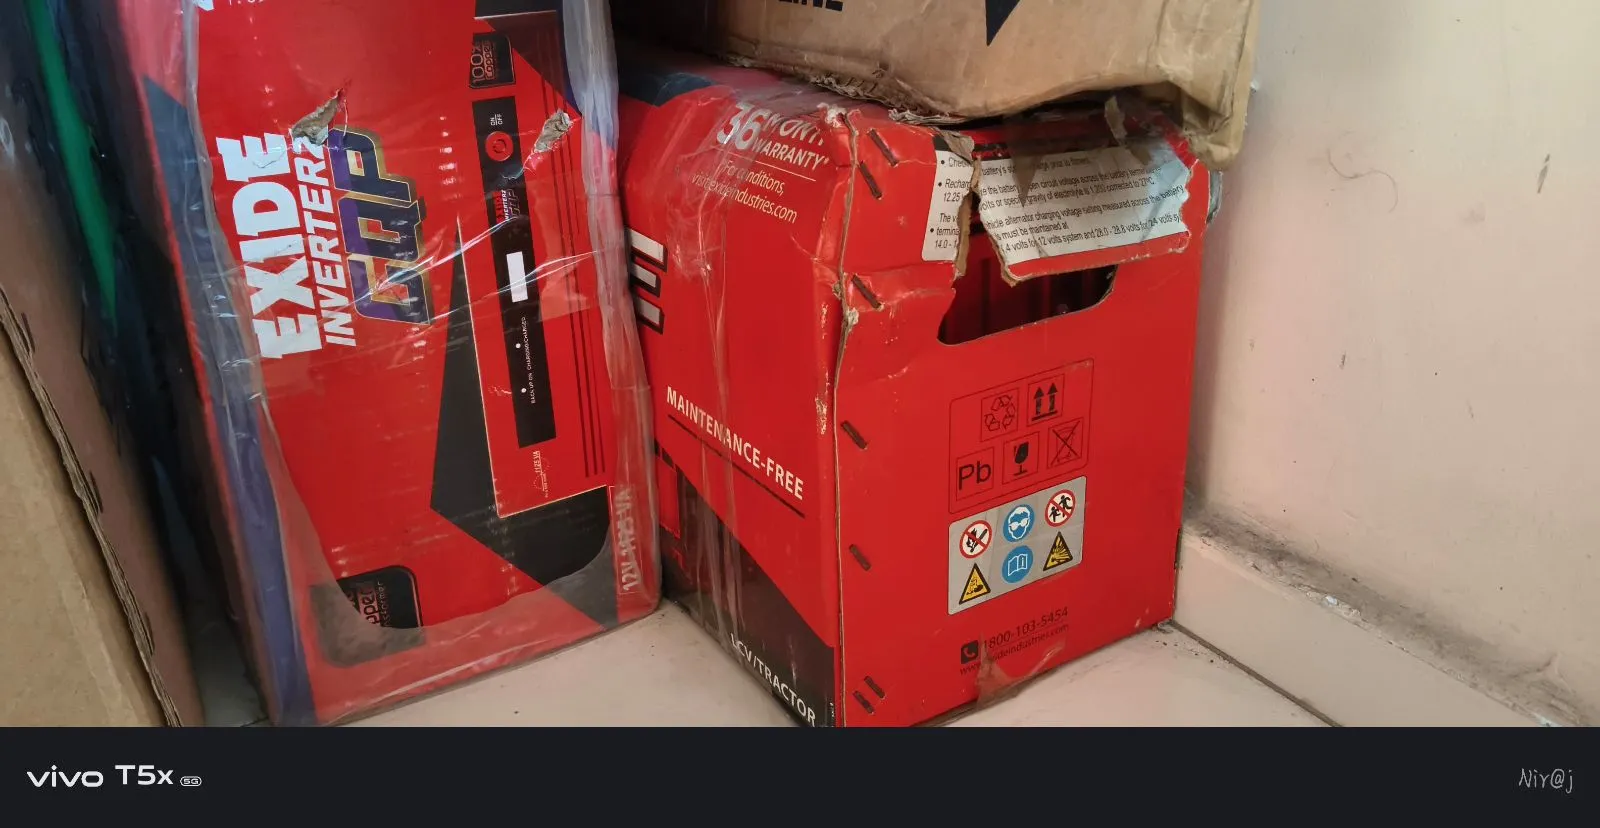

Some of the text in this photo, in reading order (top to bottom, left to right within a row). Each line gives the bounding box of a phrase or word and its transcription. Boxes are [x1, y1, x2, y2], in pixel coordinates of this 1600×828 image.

[717, 102, 773, 150] 36
[943, 192, 960, 202] 12.25
[940, 213, 951, 222] The
[1005, 213, 1034, 226] alternator
[1002, 228, 1019, 239] must
[1020, 226, 1028, 236] be
[1012, 239, 1028, 251] volts
[1039, 236, 1047, 247] 12
[1047, 234, 1062, 245] volts
[1062, 231, 1084, 244] system
[1084, 228, 1096, 239] and
[1126, 223, 1140, 233] volts
[1159, 214, 1173, 224] volts
[216, 132, 322, 359] EXIDE
[292, 136, 357, 347] INVERTERZ
[666, 385, 804, 500] MAINTENANCE-FREE
[958, 461, 992, 491] Pb
[983, 606, 1069, 650] 1800-103-5454
